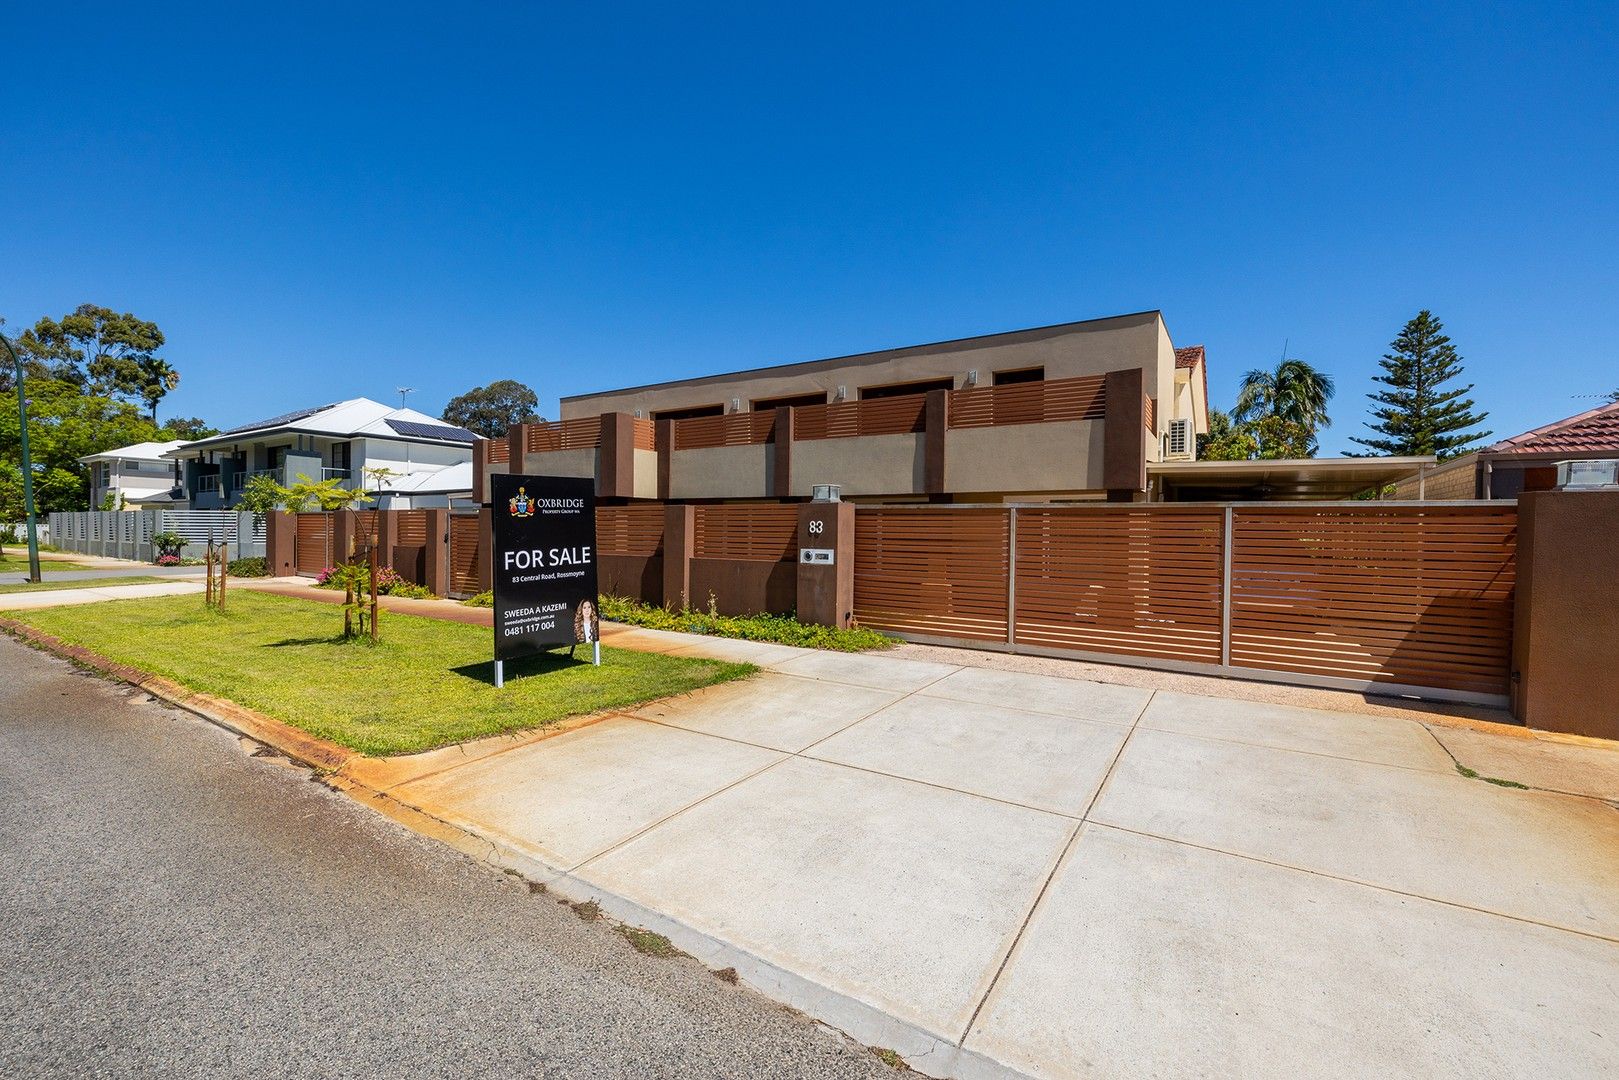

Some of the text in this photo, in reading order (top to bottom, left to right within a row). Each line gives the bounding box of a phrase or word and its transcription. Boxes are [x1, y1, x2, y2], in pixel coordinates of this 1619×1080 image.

[537, 498, 584, 508] OXBRIDGE
[809, 520, 823, 533] 83
[504, 546, 591, 570] FOR SALE
[520, 574, 541, 582] Central
[504, 602, 567, 619] SWEEDA A KAZEMI
[504, 621, 555, 637] 0481 117 004
